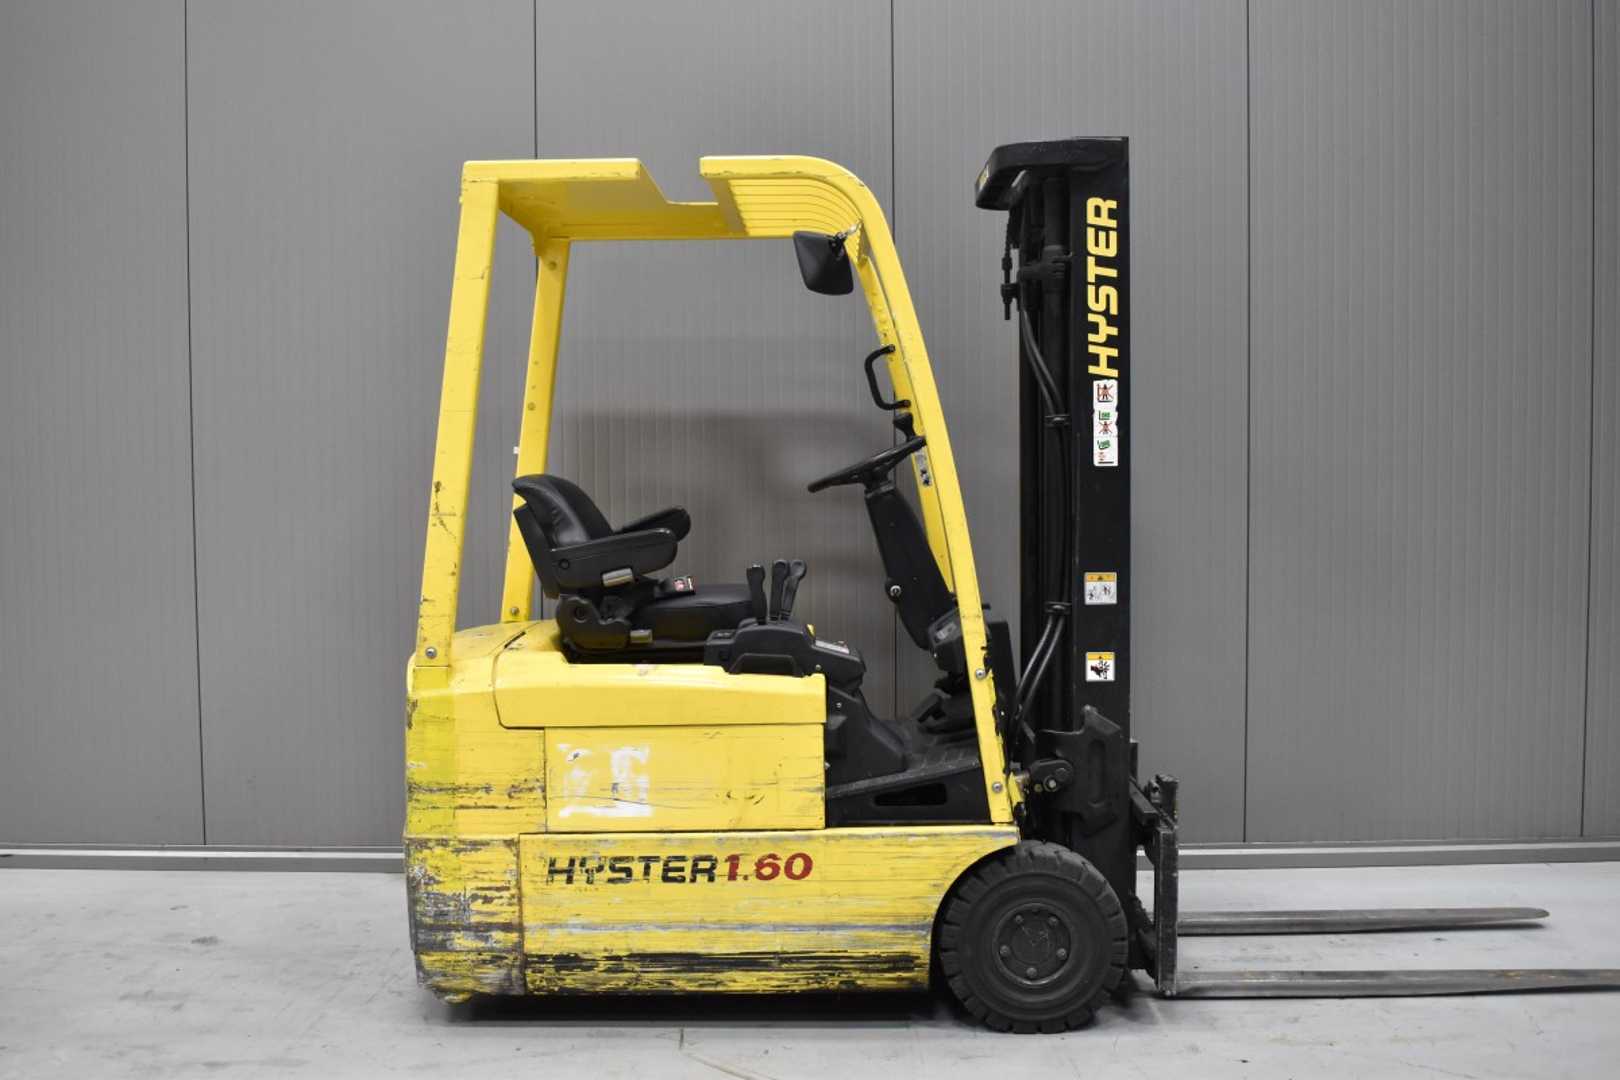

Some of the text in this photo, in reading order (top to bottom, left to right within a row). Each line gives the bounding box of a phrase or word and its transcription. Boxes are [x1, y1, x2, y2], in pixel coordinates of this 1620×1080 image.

[1086, 197, 1119, 378] HYSTER
[547, 853, 814, 884] HYSTER 1.60
